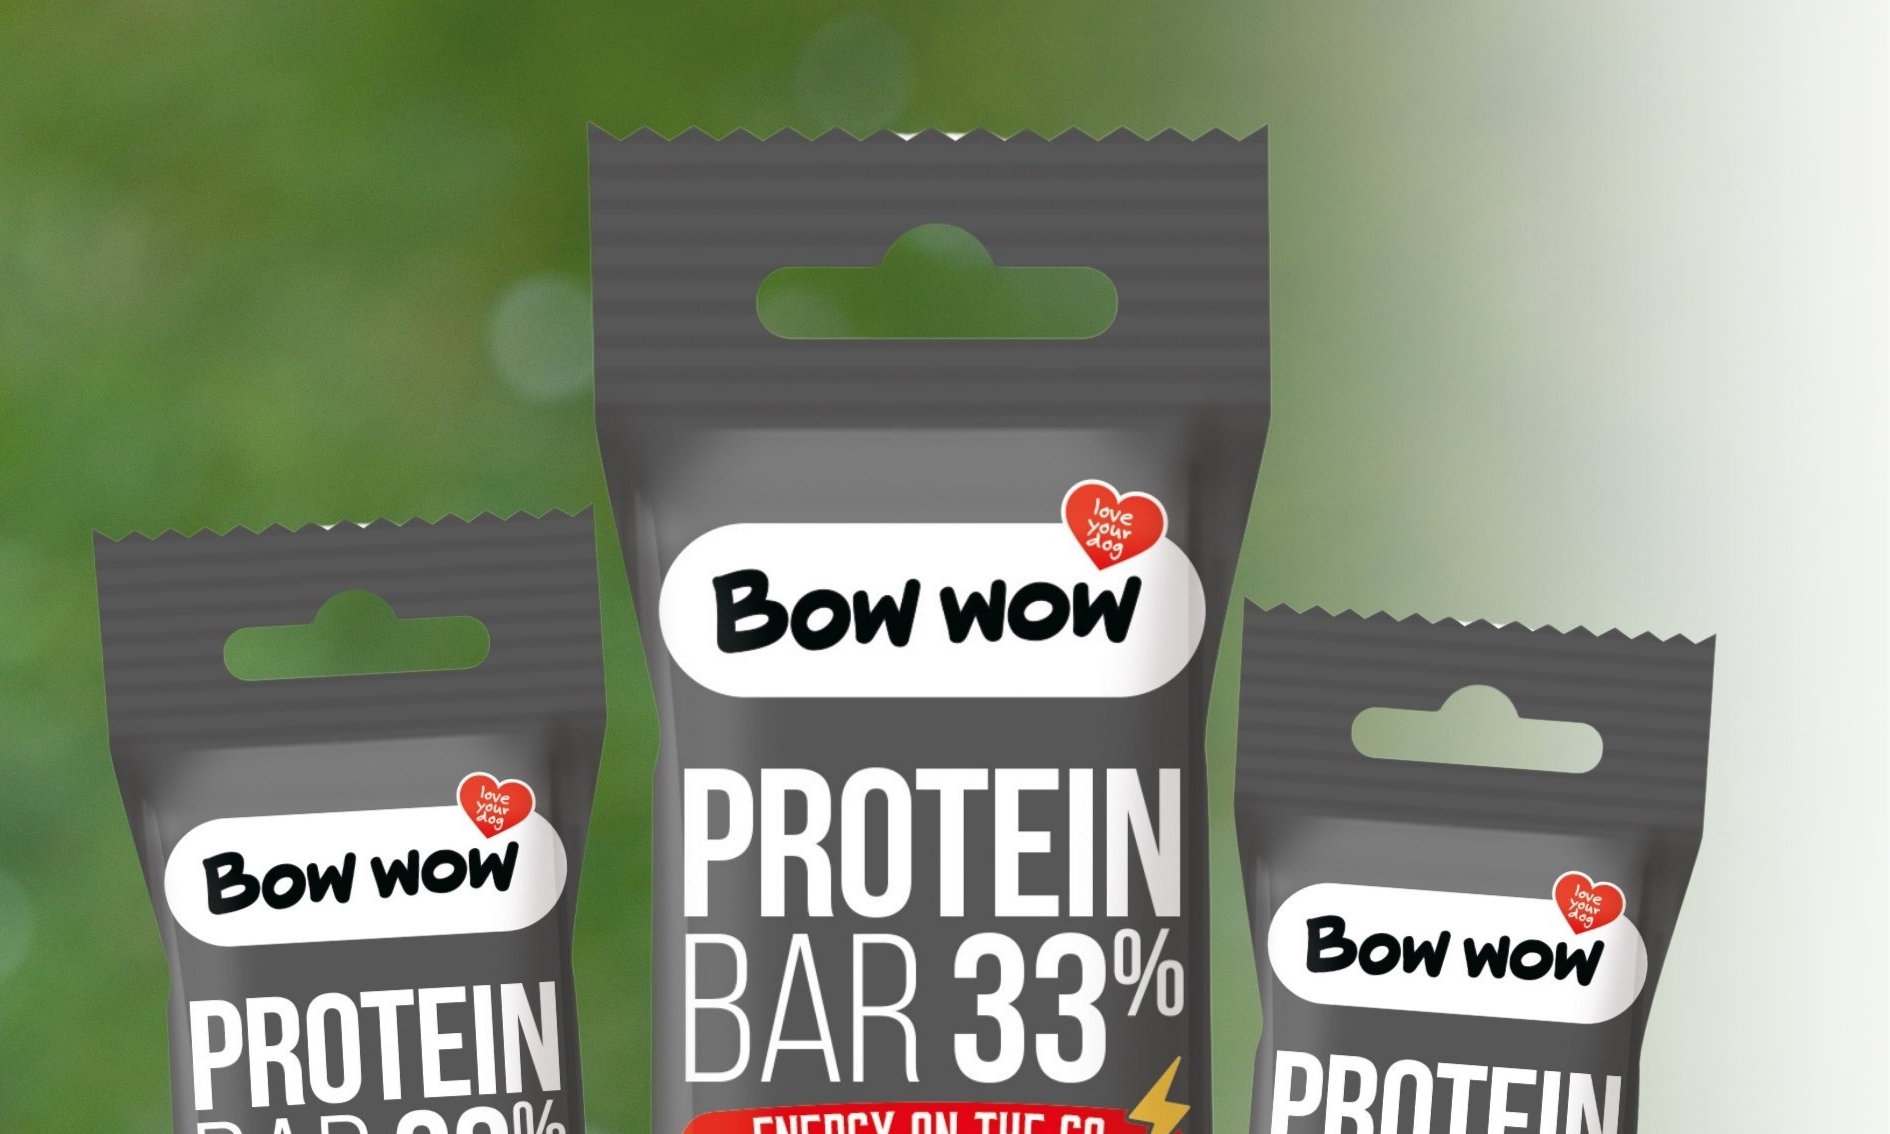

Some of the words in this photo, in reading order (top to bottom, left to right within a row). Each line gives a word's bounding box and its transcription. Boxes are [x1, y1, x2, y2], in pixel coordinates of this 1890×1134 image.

[1094, 498, 1133, 526] love
[1087, 519, 1132, 539] your
[1086, 533, 1123, 560] dog
[481, 785, 510, 805] love
[476, 801, 509, 815] your
[476, 811, 504, 830] dog
[683, 766, 1181, 919] PROTEIN
[1575, 884, 1602, 905] love
[1569, 898, 1600, 914] your
[1568, 908, 1594, 928] dog
[684, 933, 920, 1083] BAR
[953, 928, 1184, 1084] 33%
[189, 981, 561, 1110] PROTEIN
